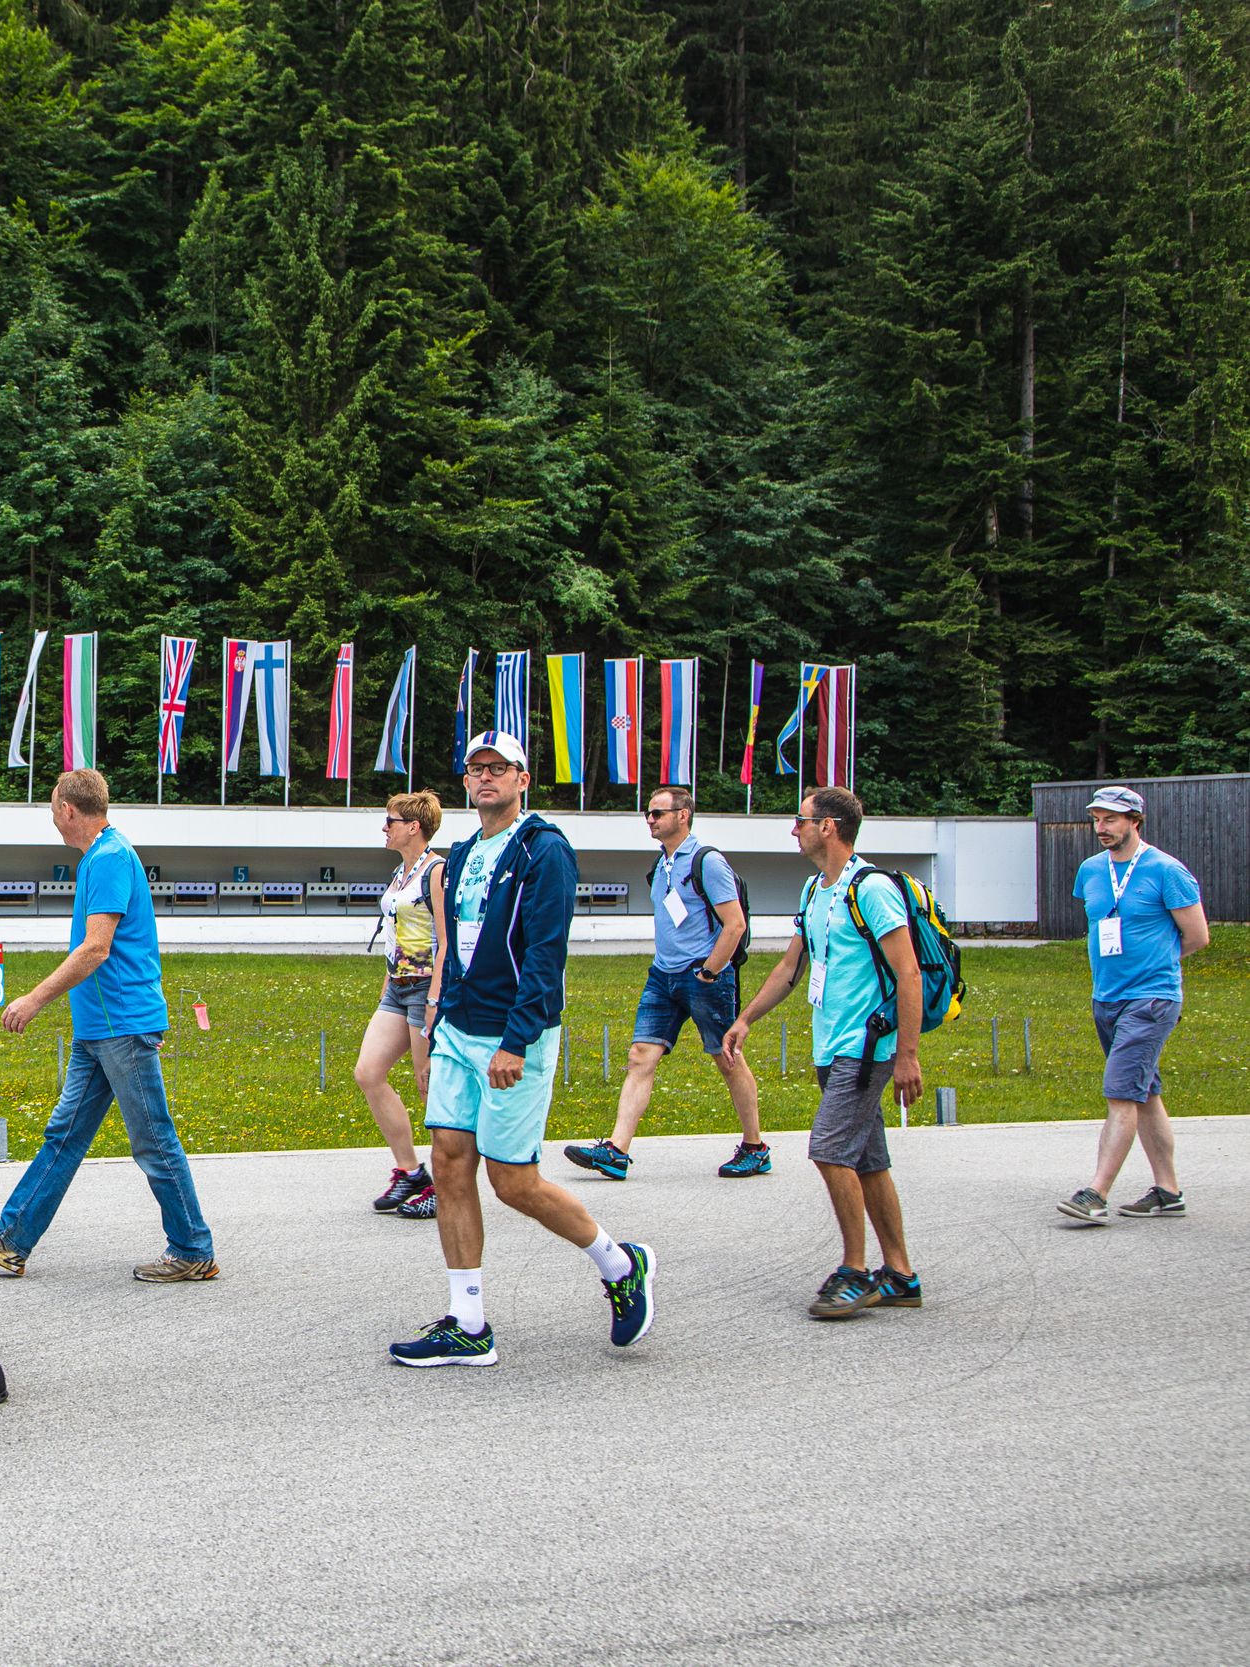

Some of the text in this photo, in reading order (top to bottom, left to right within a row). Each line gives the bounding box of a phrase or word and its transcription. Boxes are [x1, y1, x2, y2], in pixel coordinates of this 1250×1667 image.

[58, 866, 67, 881] 7
[148, 866, 157, 882] 6
[237, 866, 245, 882] 5
[323, 867, 333, 882] 4
